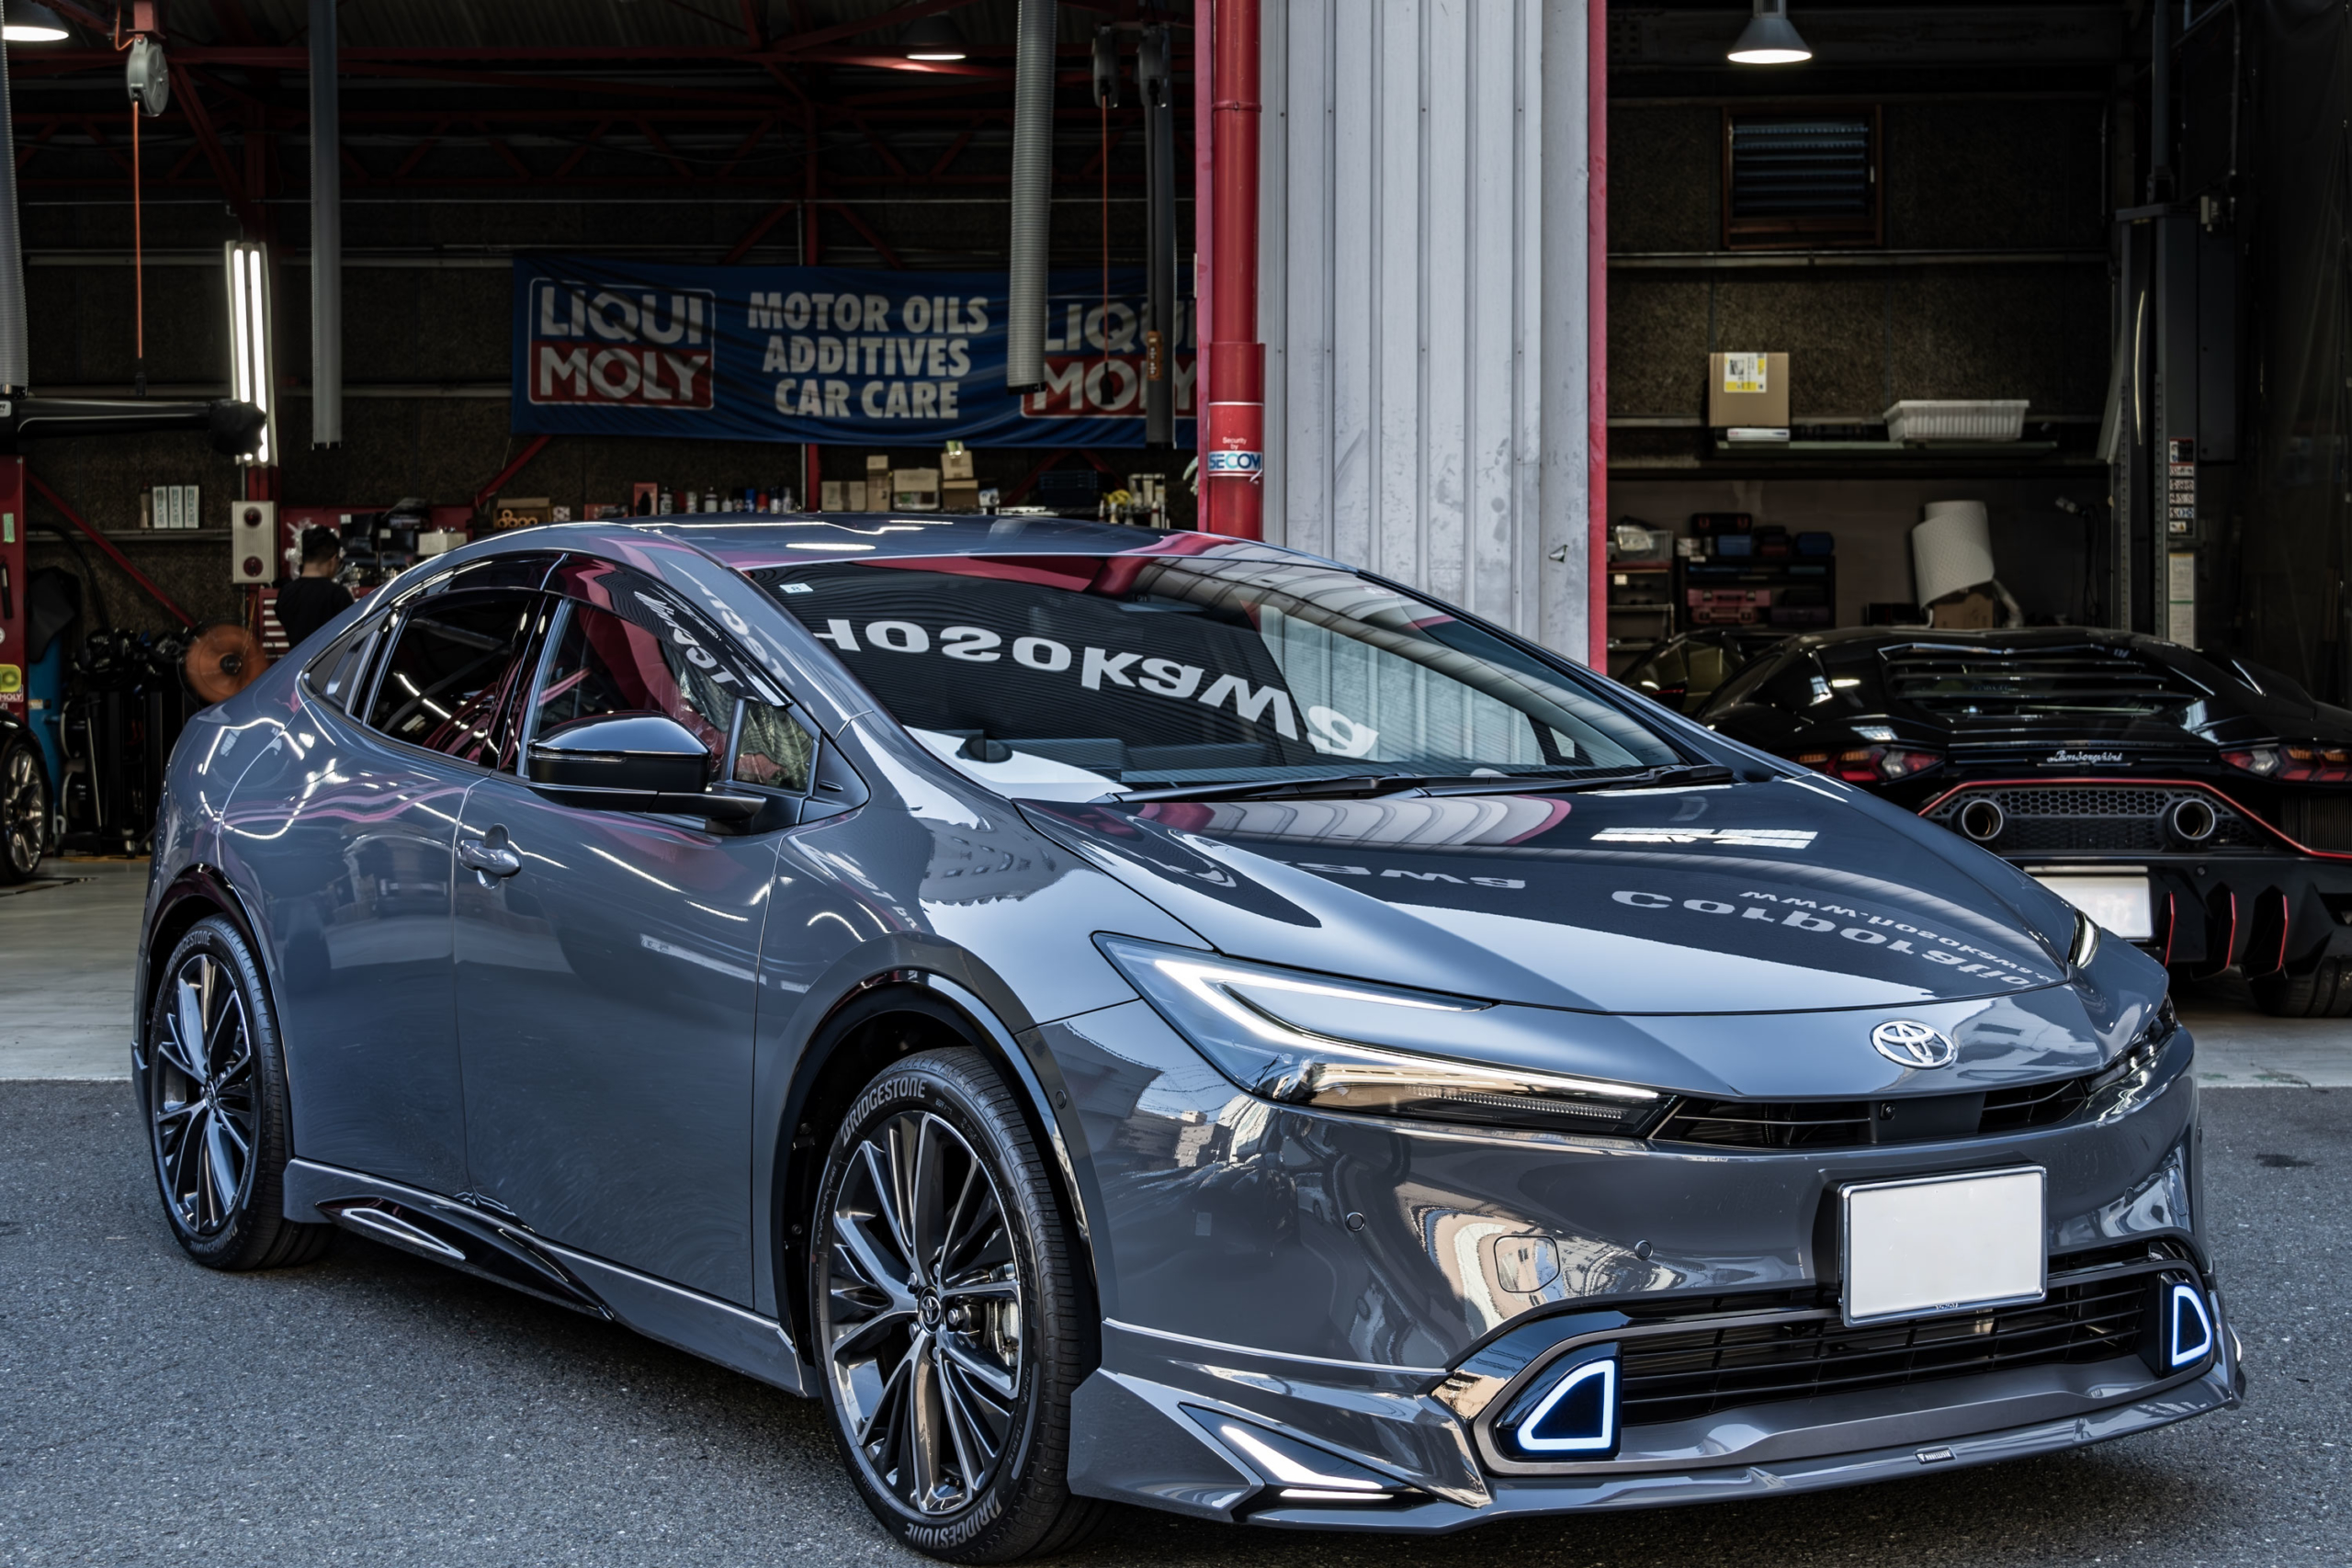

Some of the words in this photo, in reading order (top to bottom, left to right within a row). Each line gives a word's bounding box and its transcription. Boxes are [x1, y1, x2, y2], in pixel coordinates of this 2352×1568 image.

[540, 285, 704, 345] LIQUI
[748, 291, 890, 333] MOTOR
[902, 295, 989, 334] OILS
[538, 345, 708, 404] MOLY
[763, 336, 972, 378] ADDITIVES
[774, 378, 853, 418] CAR
[860, 379, 960, 420] CARE
[1222, 436, 1247, 446] Security
[2046, 749, 2122, 763] Lamborghini
[840, 1077, 928, 1147] BRIDGESTONE
[904, 1487, 1002, 1550] BRIDGESTONE
